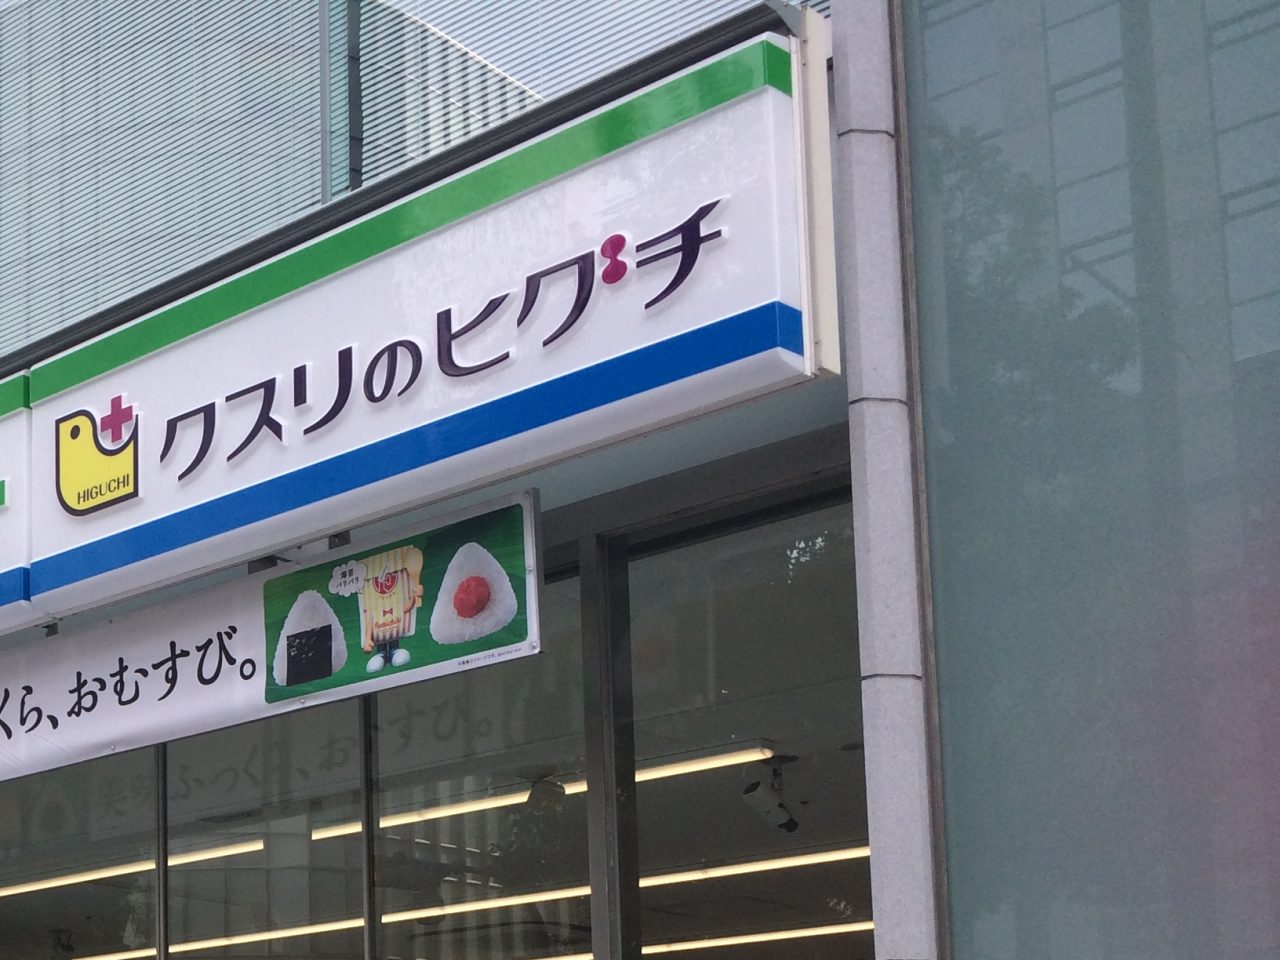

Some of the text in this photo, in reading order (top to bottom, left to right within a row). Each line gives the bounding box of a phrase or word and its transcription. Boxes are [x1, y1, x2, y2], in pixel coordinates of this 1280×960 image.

[159, 198, 722, 482] クスリのヒグチ
[76, 474, 131, 506] HIGUCHI
